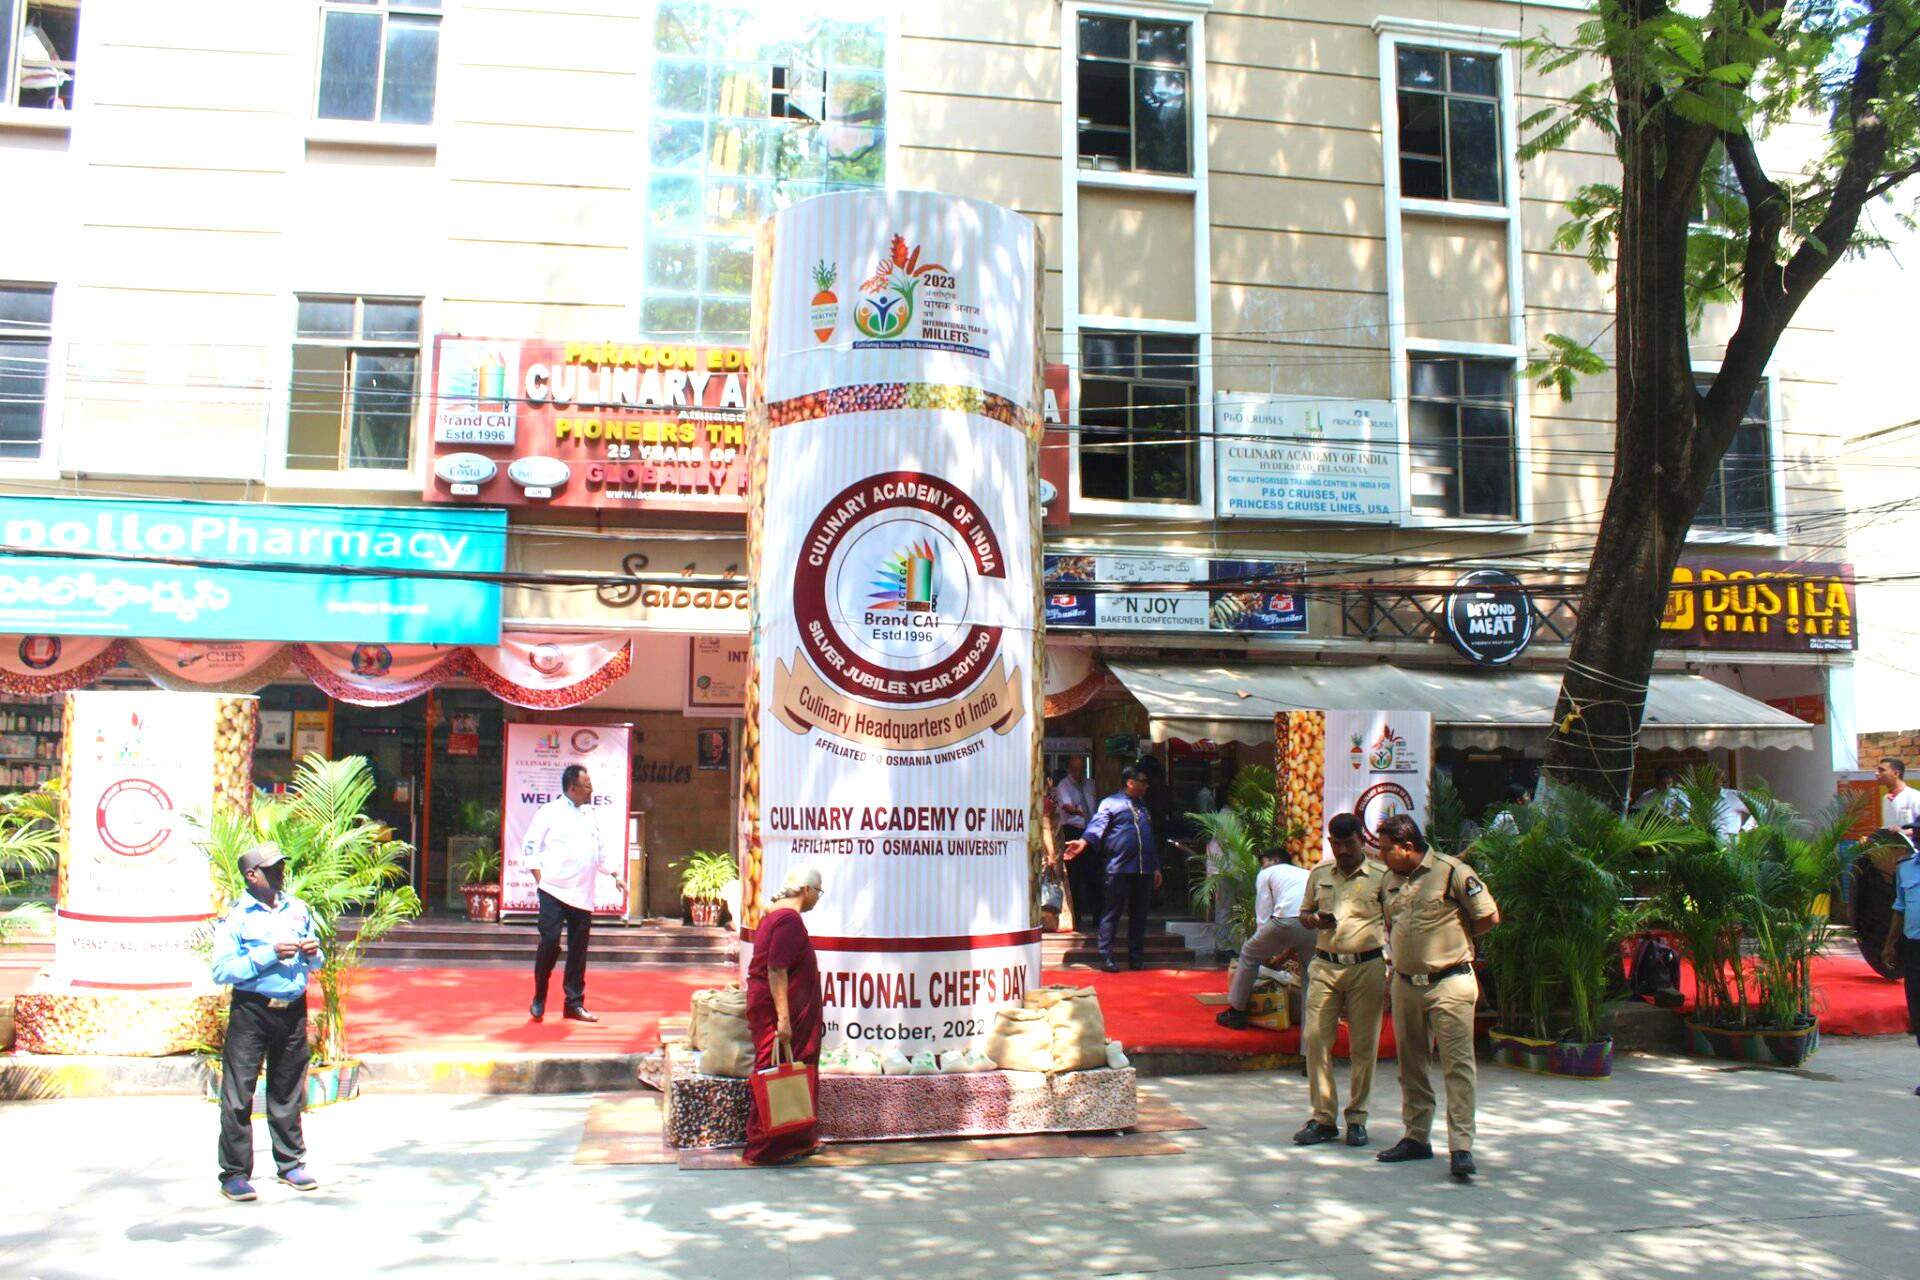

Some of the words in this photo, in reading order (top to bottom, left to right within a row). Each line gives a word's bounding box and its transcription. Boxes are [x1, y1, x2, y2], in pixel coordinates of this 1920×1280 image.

[924, 274, 955, 289] 2023
[922, 319, 967, 332] INTERNATIONAL
[968, 325, 981, 333] YEAR
[922, 327, 969, 343] MILLETS
[564, 342, 697, 365] PARAGON
[525, 364, 712, 407] CULINARY
[719, 372, 748, 407] A
[439, 415, 482, 426] Brand
[486, 416, 511, 427] CAI
[678, 410, 747, 422] Affiliated
[1223, 412, 1243, 423] P&O
[1246, 413, 1284, 425] CRUISES
[1333, 418, 1363, 427] PRINCESS
[446, 429, 505, 440] Estd.1996
[556, 419, 696, 442] PIONEERS
[607, 445, 631, 458] 25
[638, 446, 703, 461] YEARS
[710, 449, 736, 462] OF
[1229, 448, 1284, 460] CULINARY
[1287, 450, 1339, 463] ACADEMY
[1342, 454, 1356, 464] OF
[1359, 454, 1388, 465] INDIA
[450, 467, 481, 477] Costa
[586, 463, 727, 488] GLOBALLY
[1260, 462, 1314, 473] HYDERABAD,
[1317, 464, 1368, 474] TELANGANA
[1228, 475, 1244, 483] ONLY
[1247, 476, 1289, 486] AUTHORISED
[1291, 477, 1321, 487] TRAINING
[1323, 479, 1348, 488] CENTRE
[1350, 480, 1357, 488] IN
[1359, 481, 1376, 489] INDIA
[1378, 481, 1391, 489] FOR
[1262, 487, 1285, 498] P&O
[1289, 488, 1339, 501] CRUISES,
[1342, 491, 1357, 500] UK
[1229, 499, 1284, 510] PRINCESS
[1287, 501, 1327, 512] CRUISE
[1330, 503, 1365, 514] LINES,
[1368, 505, 1390, 514] USA
[808, 492, 866, 566] CULINARY
[873, 481, 953, 509] ACADEMY
[953, 504, 974, 526] OF
[969, 525, 996, 573] INDIA
[1701, 569, 1851, 616] DOSTEA
[1126, 598, 1138, 613] N
[1144, 598, 1180, 613] JOY
[1467, 603, 1515, 617] BEYOND
[864, 612, 909, 626] Brand
[913, 614, 939, 628] CAI
[1101, 615, 1133, 623] BAKERS
[1141, 616, 1205, 625] CONFECTIONERS
[1469, 616, 1516, 635] MEAT
[1704, 614, 1768, 632] CHAI
[1785, 617, 1850, 635] CAFE
[872, 629, 933, 642] Estd.1996
[808, 620, 845, 671] SILVER
[843, 666, 907, 695] JUBILEE
[910, 675, 952, 696] YEAR
[951, 631, 991, 681] 2019-20
[798, 686, 852, 734] Culinary
[855, 712, 950, 744] Headquarters
[955, 706, 968, 729] of
[968, 692, 998, 720] India
[815, 737, 866, 762] AFFILIATED
[871, 755, 882, 764] TO
[886, 755, 932, 766] OSMANIA
[934, 739, 985, 764] UNIVERSITY
[770, 807, 854, 831] CULINARY
[860, 806, 959, 831] ACADEMY
[965, 807, 986, 831] OF
[992, 808, 1024, 832] INDIA
[791, 839, 854, 855] AFFILIATED
[857, 839, 874, 855] TO
[882, 839, 944, 856] OSMANIA
[947, 840, 1008, 856] UNIVERSITY
[929, 969, 997, 1008] CHEF'S
[1003, 964, 1027, 1001] DAY
[846, 1022, 936, 1042] October,
[943, 1019, 985, 1039] 2022
